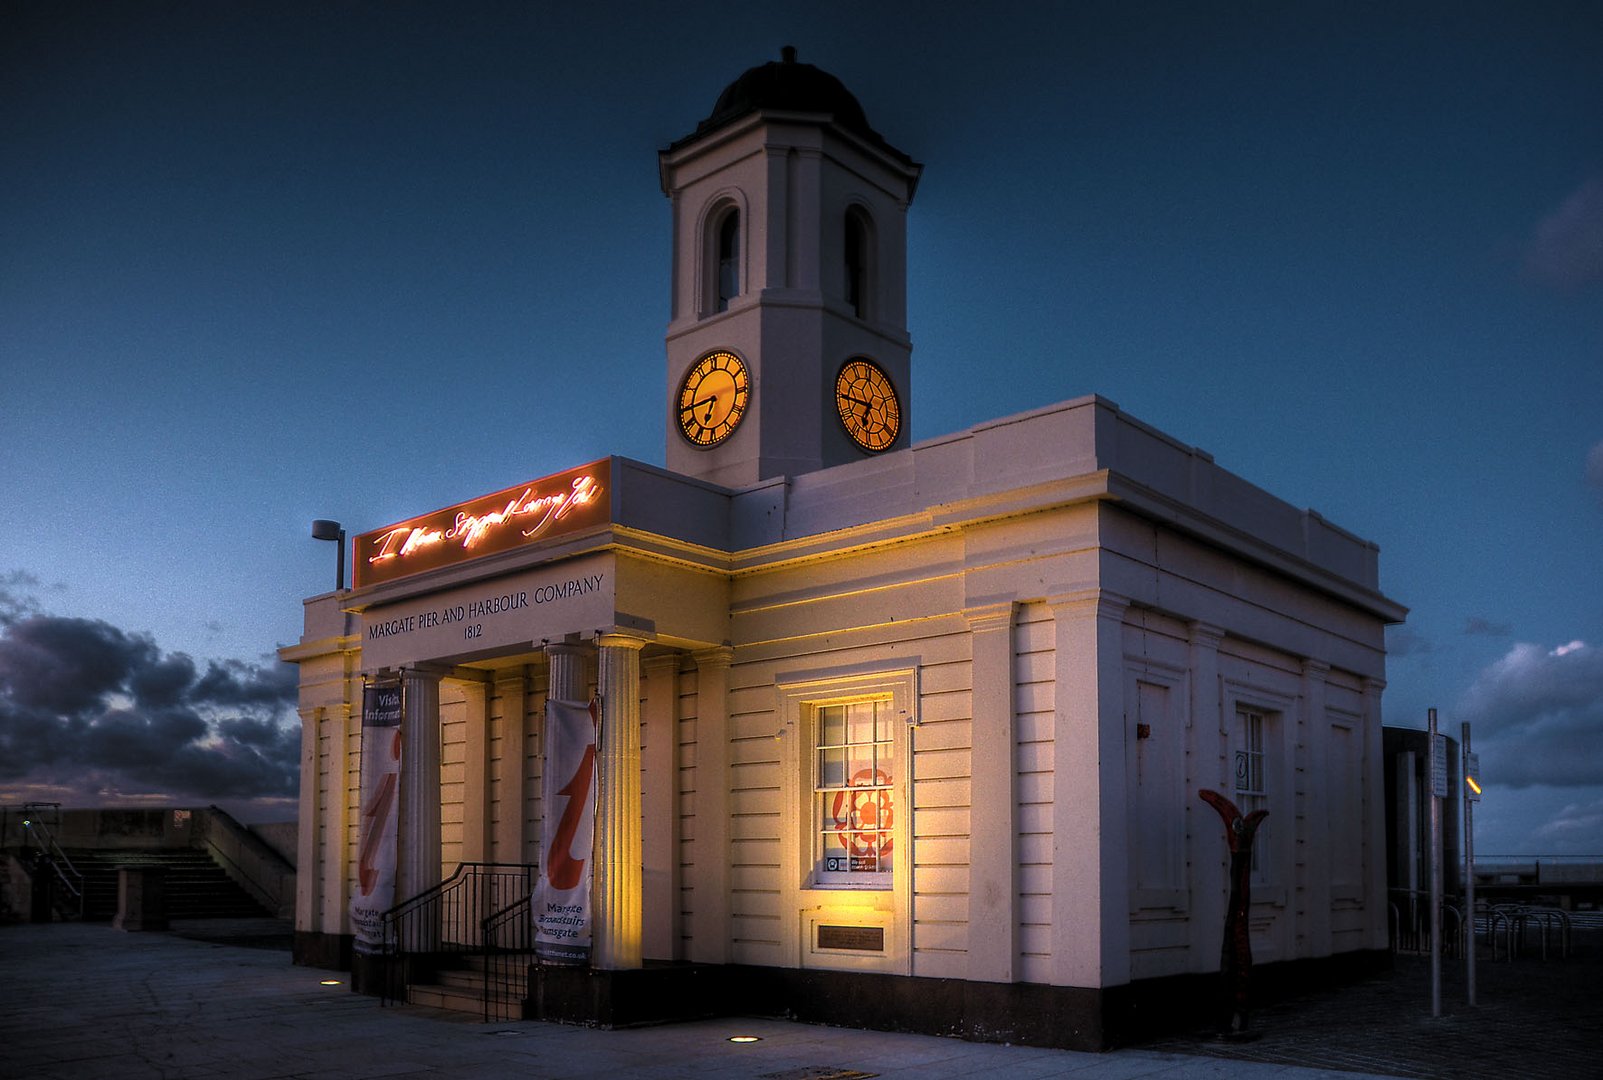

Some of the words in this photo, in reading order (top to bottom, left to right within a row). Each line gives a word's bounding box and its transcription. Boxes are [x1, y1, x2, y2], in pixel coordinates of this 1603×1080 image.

[368, 616, 415, 640] MARGATE
[418, 611, 439, 629] PIER
[441, 606, 465, 624] AND
[468, 592, 529, 618] HARBOUR
[534, 573, 604, 605] COMPANY
[463, 623, 483, 640] 1812
[540, 926, 579, 940] amsgate
